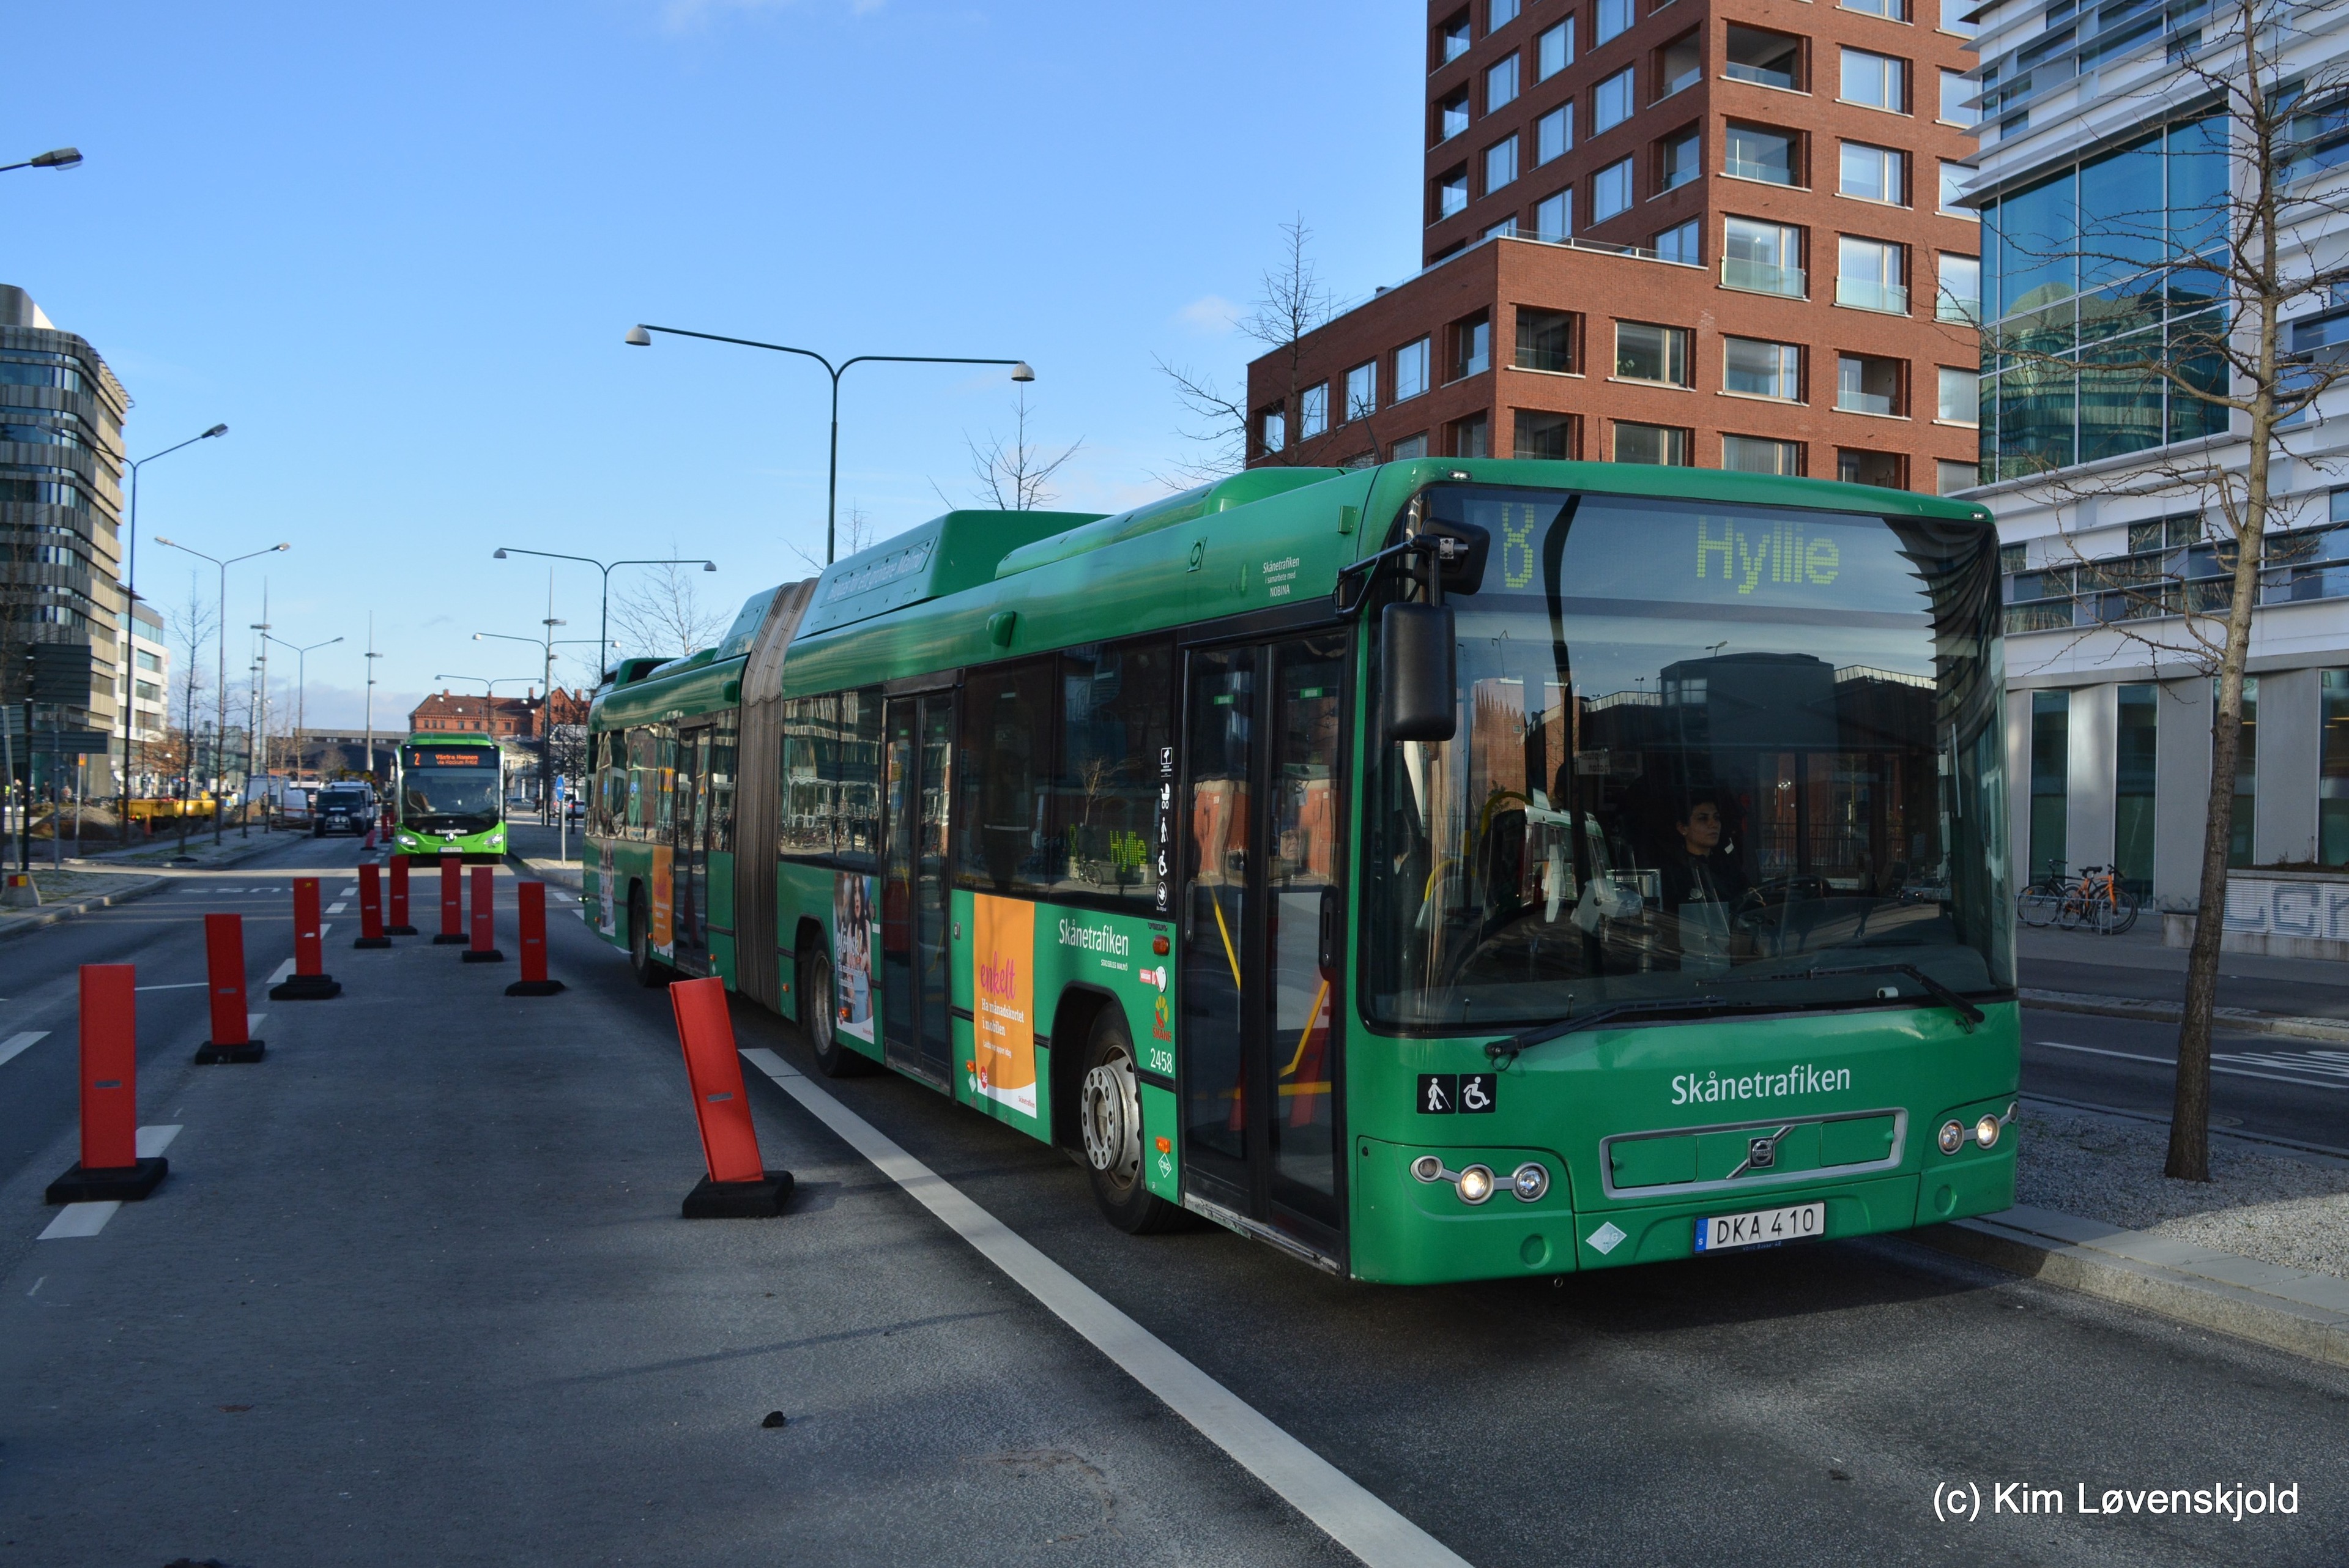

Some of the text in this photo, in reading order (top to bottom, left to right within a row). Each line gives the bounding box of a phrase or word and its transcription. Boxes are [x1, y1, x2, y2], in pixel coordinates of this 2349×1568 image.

[1502, 501, 1840, 595] 8 Hyllie
[1263, 556, 1300, 574] Skånetrafiken
[1267, 573, 1286, 584] samarbete
[1287, 570, 1296, 579] med
[1270, 584, 1290, 598] NOBINA
[414, 752, 420, 765] 2
[1110, 830, 1147, 873] Hyllie
[1059, 918, 1129, 956] Skånetrafiken
[981, 951, 1017, 1000] enkelt
[981, 998, 1025, 1023] Ha månadskortet
[985, 1020, 1006, 1036] mobilen
[1150, 1047, 1173, 1074] 2458
[1671, 1065, 1851, 1107] Skånetrafiken
[1160, 1160, 1170, 1172] CNG
[1716, 1208, 1814, 1245] DKA 410
